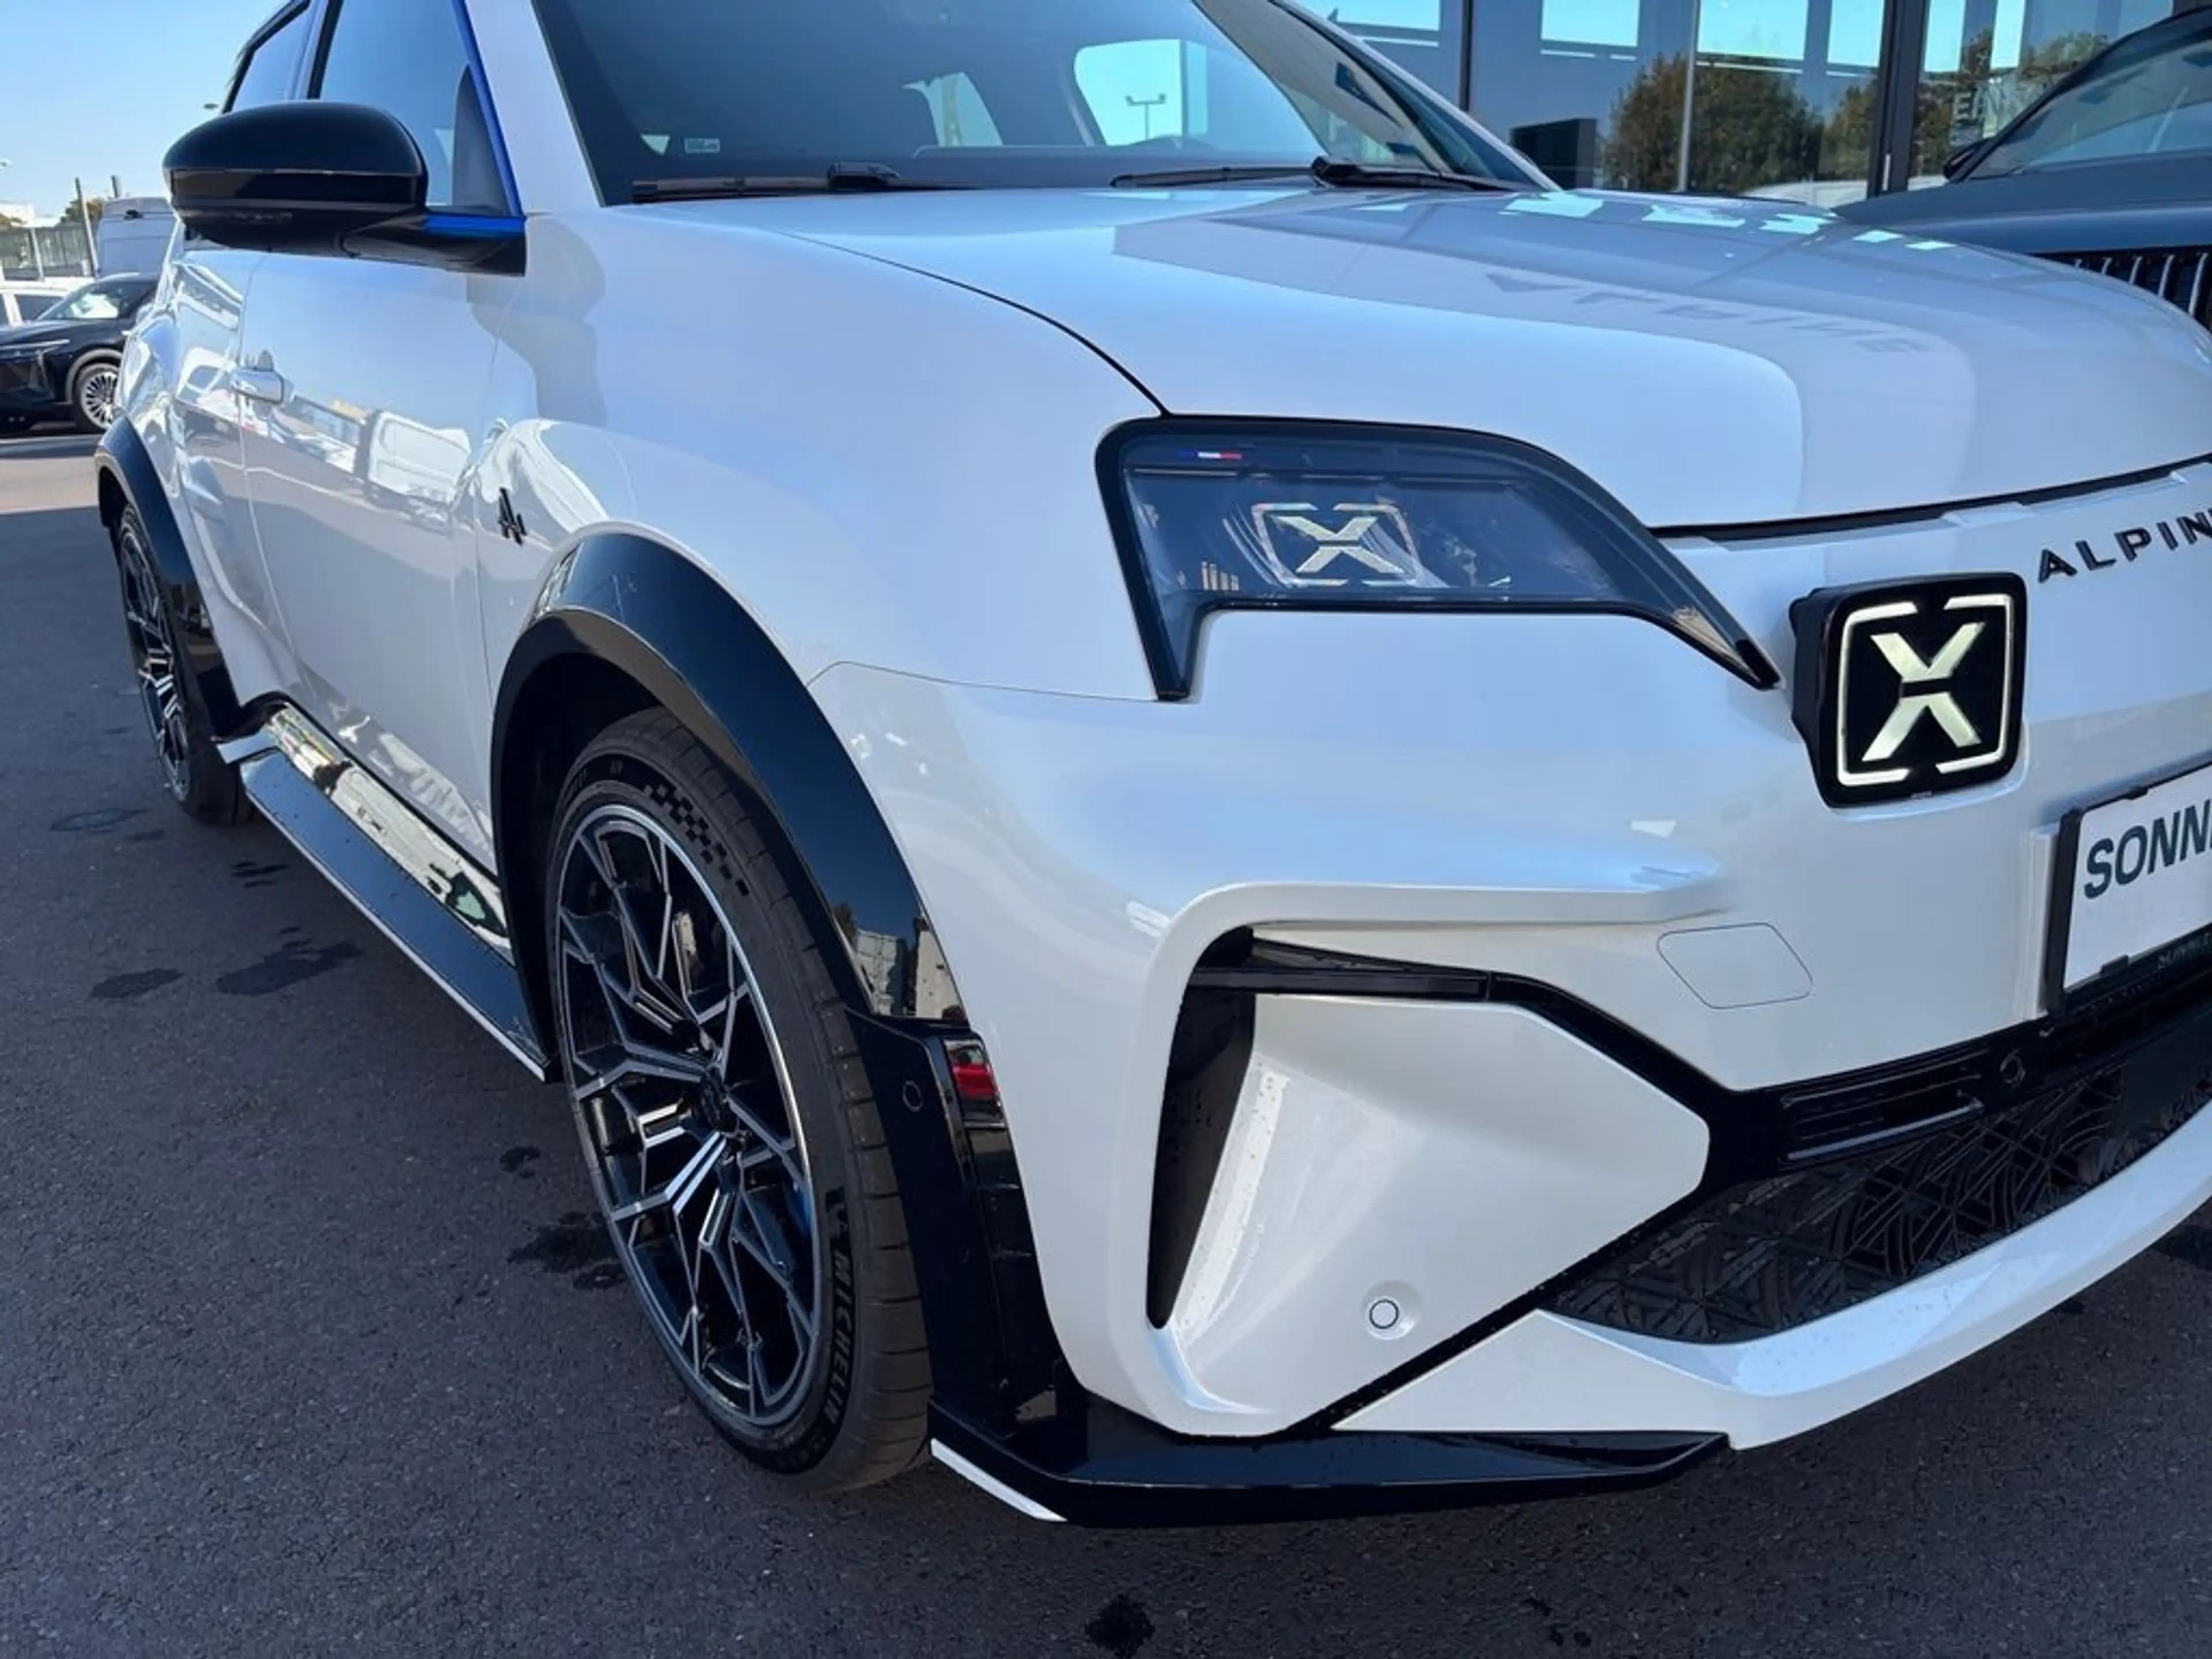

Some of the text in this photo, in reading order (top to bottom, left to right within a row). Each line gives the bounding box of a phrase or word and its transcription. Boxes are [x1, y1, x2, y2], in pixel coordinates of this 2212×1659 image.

[2037, 509, 2212, 584] ALPIN
[2084, 798, 2212, 899] SONN
[824, 1249, 853, 1425] MICHELIN
